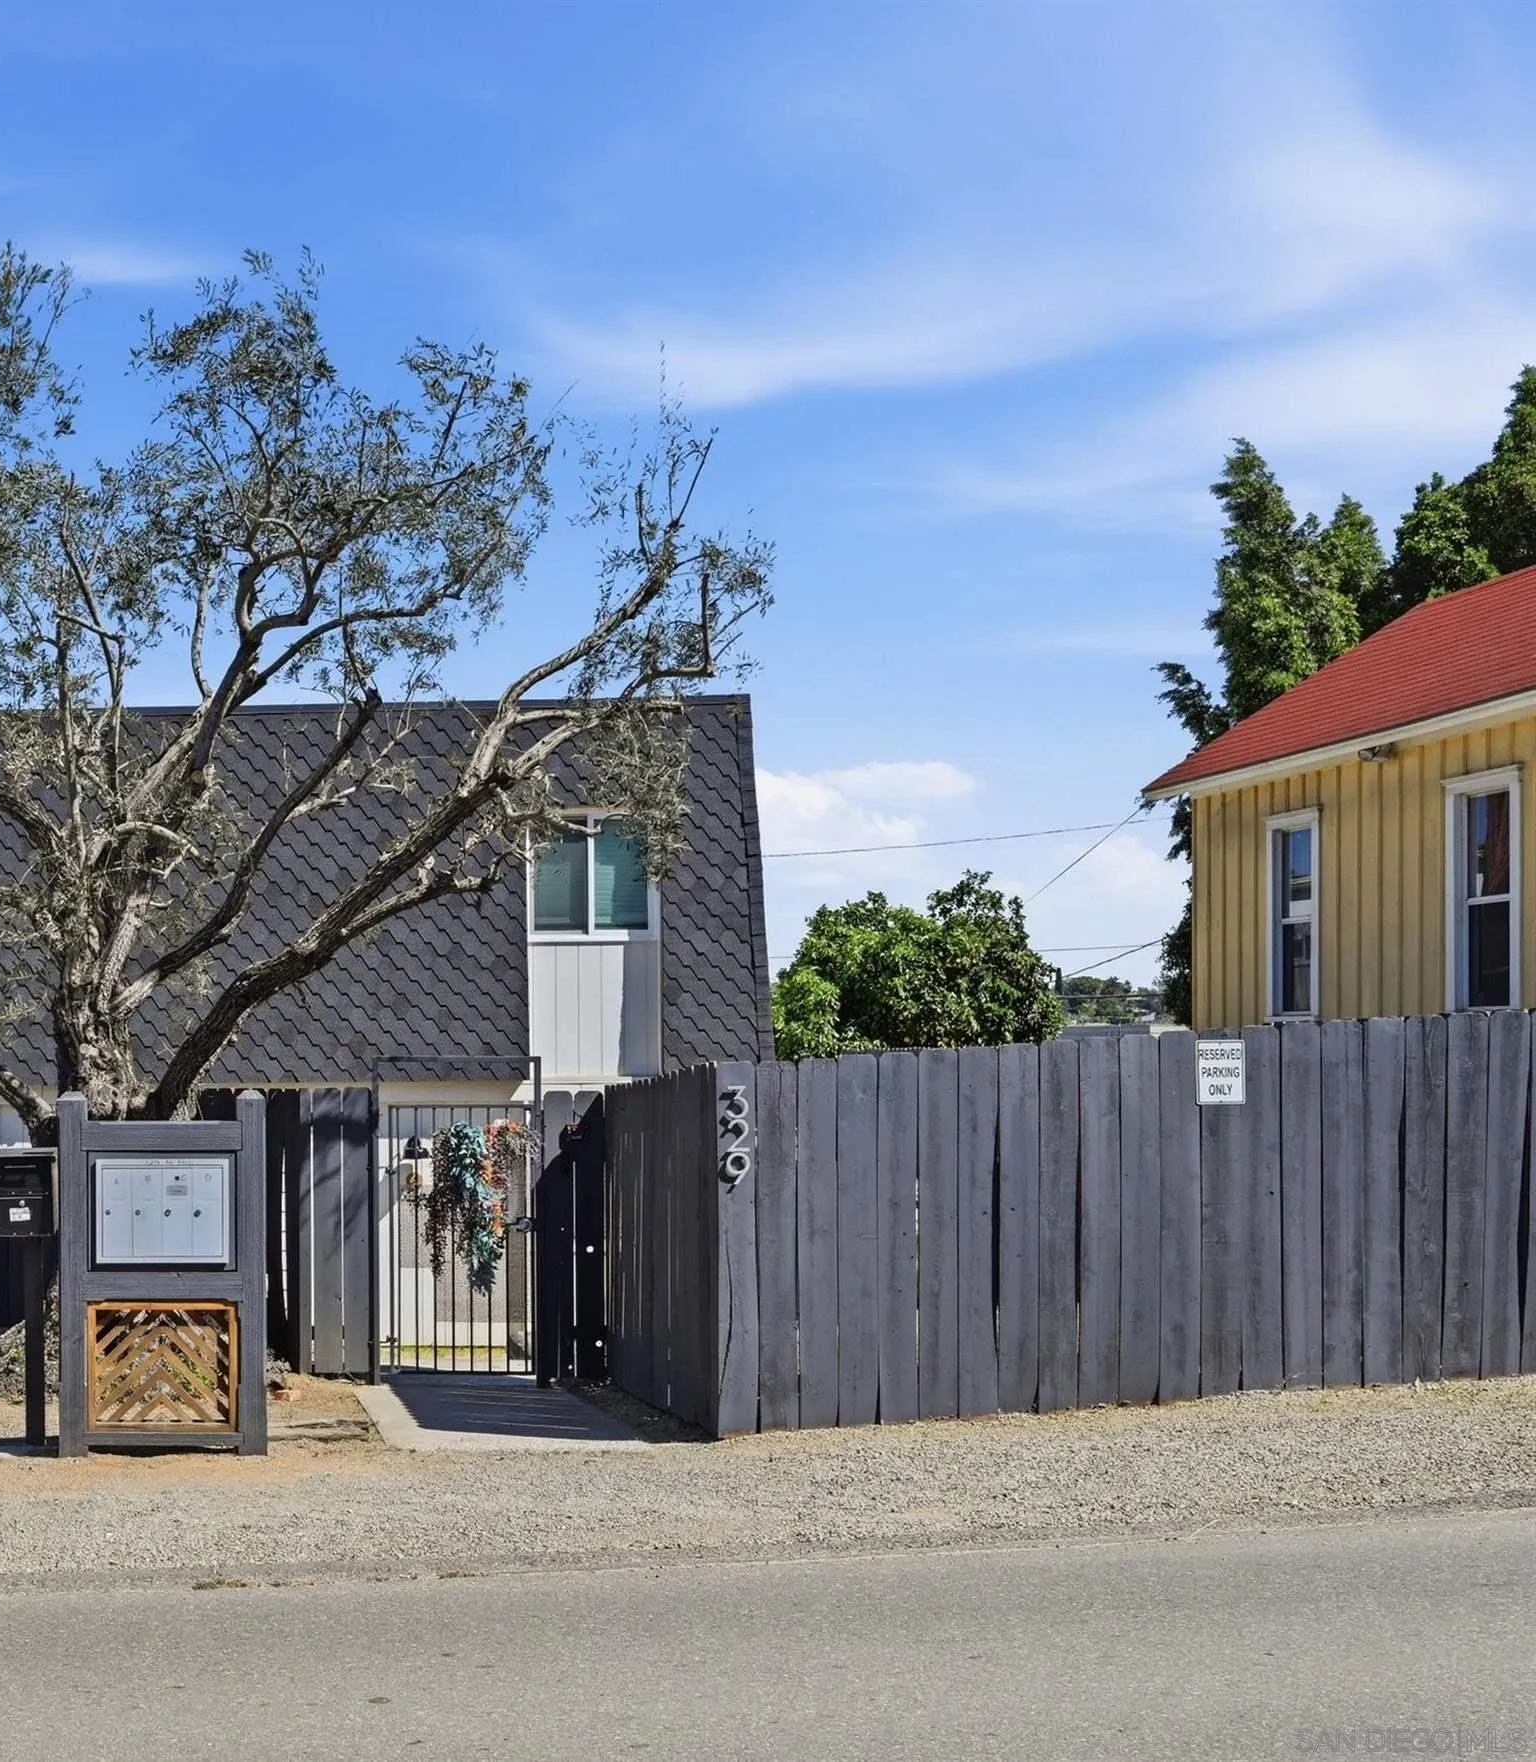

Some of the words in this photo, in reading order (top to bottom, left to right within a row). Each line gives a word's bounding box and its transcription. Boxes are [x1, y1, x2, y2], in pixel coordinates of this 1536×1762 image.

[1198, 1048, 1241, 1060] RESERVED
[1201, 1066, 1240, 1078] PARKING
[1208, 1084, 1233, 1096] ONLY
[725, 1085, 751, 1185] 329
